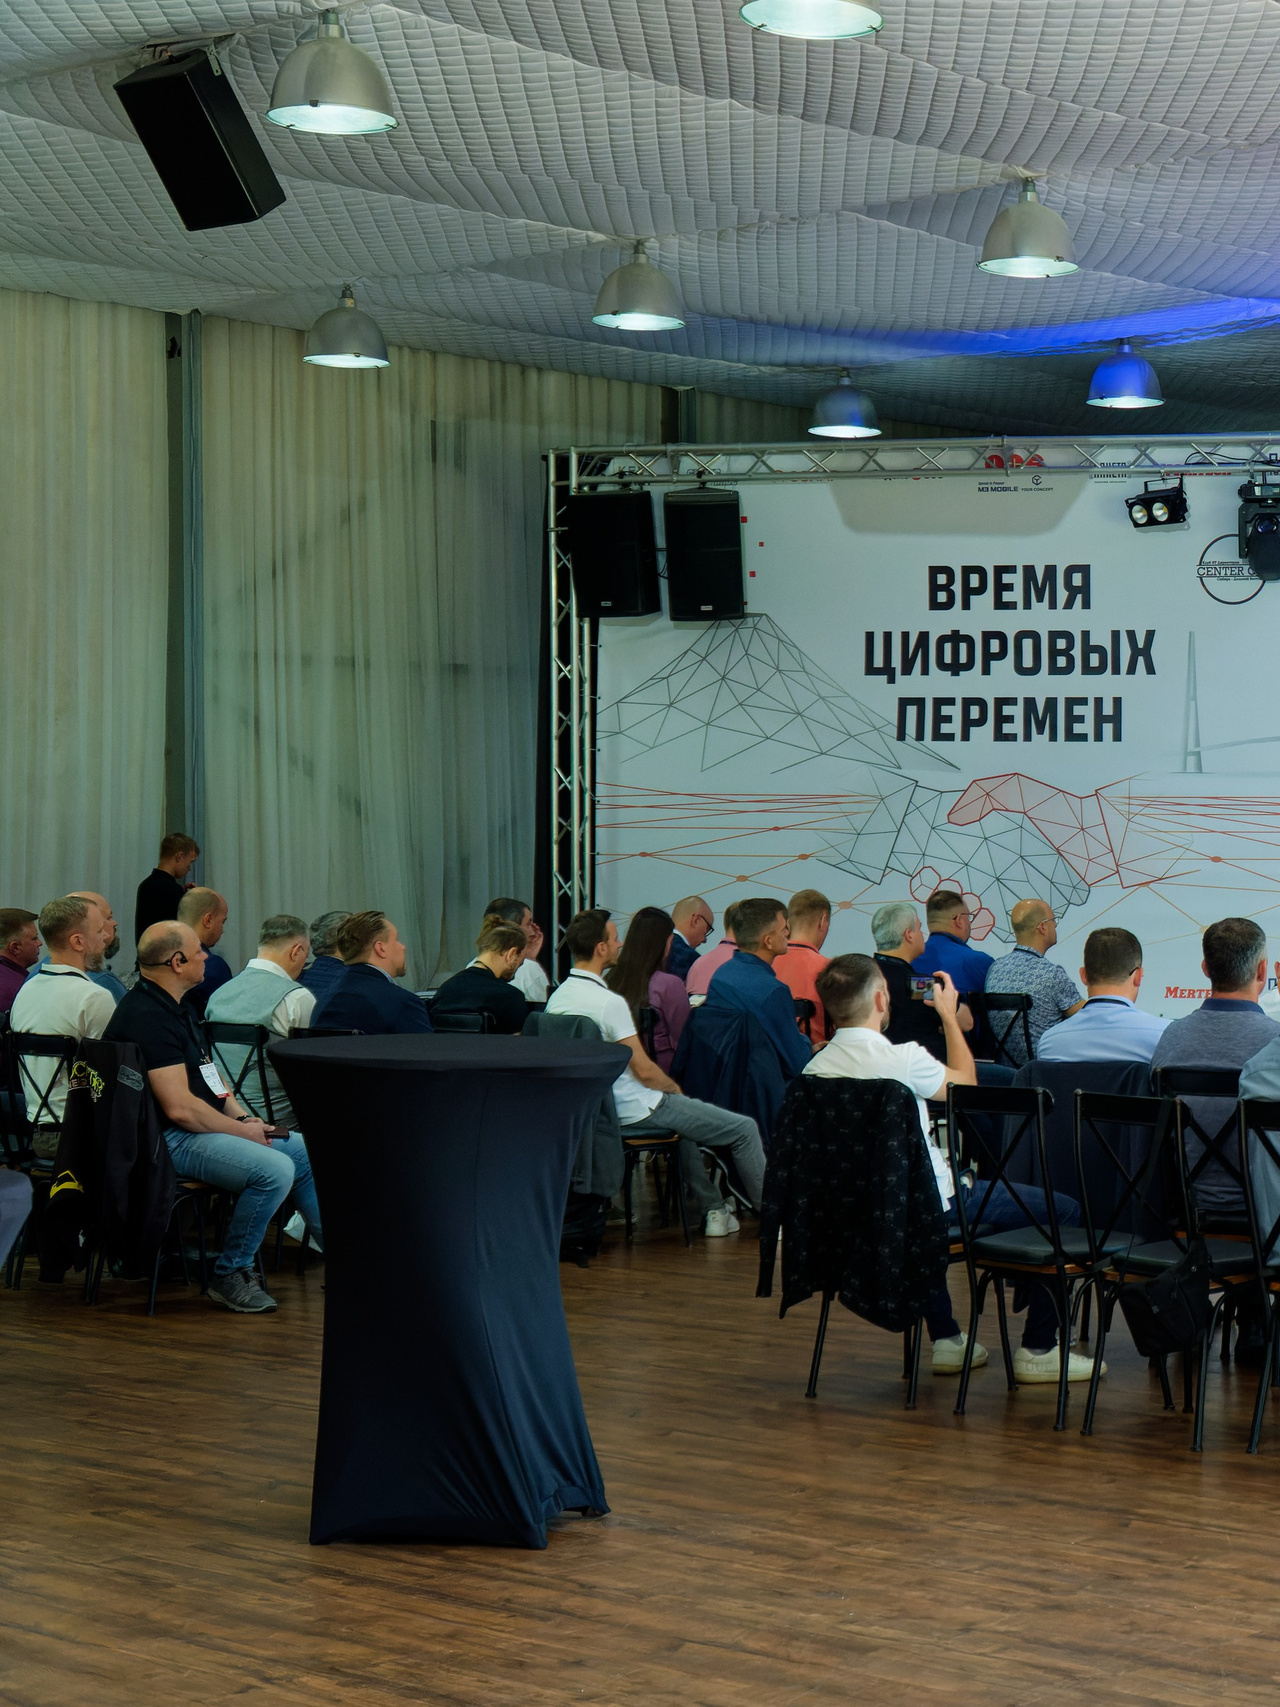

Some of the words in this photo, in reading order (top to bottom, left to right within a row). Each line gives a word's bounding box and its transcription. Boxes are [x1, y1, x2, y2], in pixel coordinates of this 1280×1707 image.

[928, 564, 1091, 611] ВРЕМЯ
[1197, 566, 1244, 576] CENTER
[864, 630, 1156, 684] ЦИФРОВЫХ
[896, 697, 1122, 742] ПЕРЕМЕН
[1164, 986, 1212, 998] MERTE
